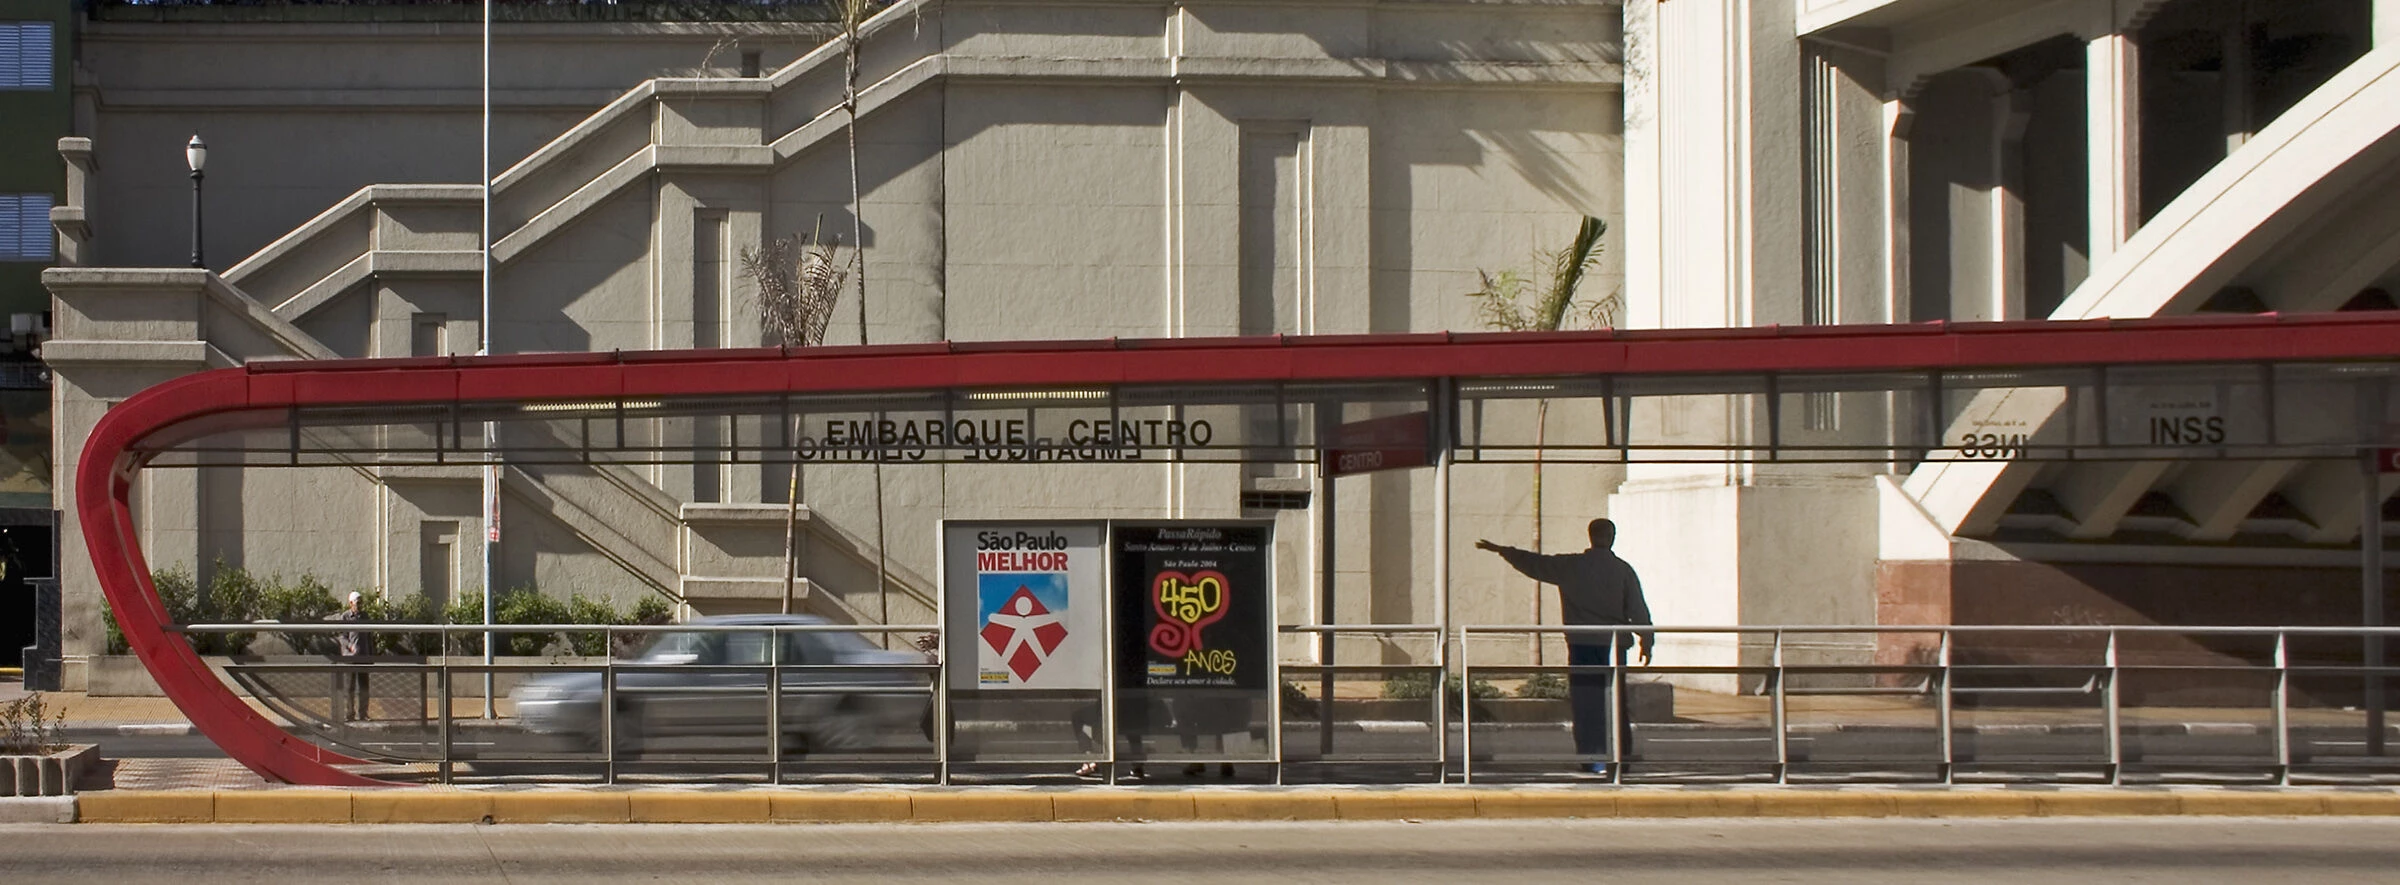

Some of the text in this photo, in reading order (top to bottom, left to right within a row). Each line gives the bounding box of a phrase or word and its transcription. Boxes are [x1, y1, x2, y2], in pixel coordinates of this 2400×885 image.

[826, 419, 1213, 446] EMBARQUE CENTRO
[2149, 416, 2225, 444] INSS
[1340, 451, 1383, 470] CENTRO
[977, 530, 1068, 551] São Paulo
[977, 552, 1068, 571] MELHOR
[1163, 560, 1217, 568] São Paulo 2004
[1160, 577, 1222, 624] 450
[1183, 649, 1236, 676] ANOS
